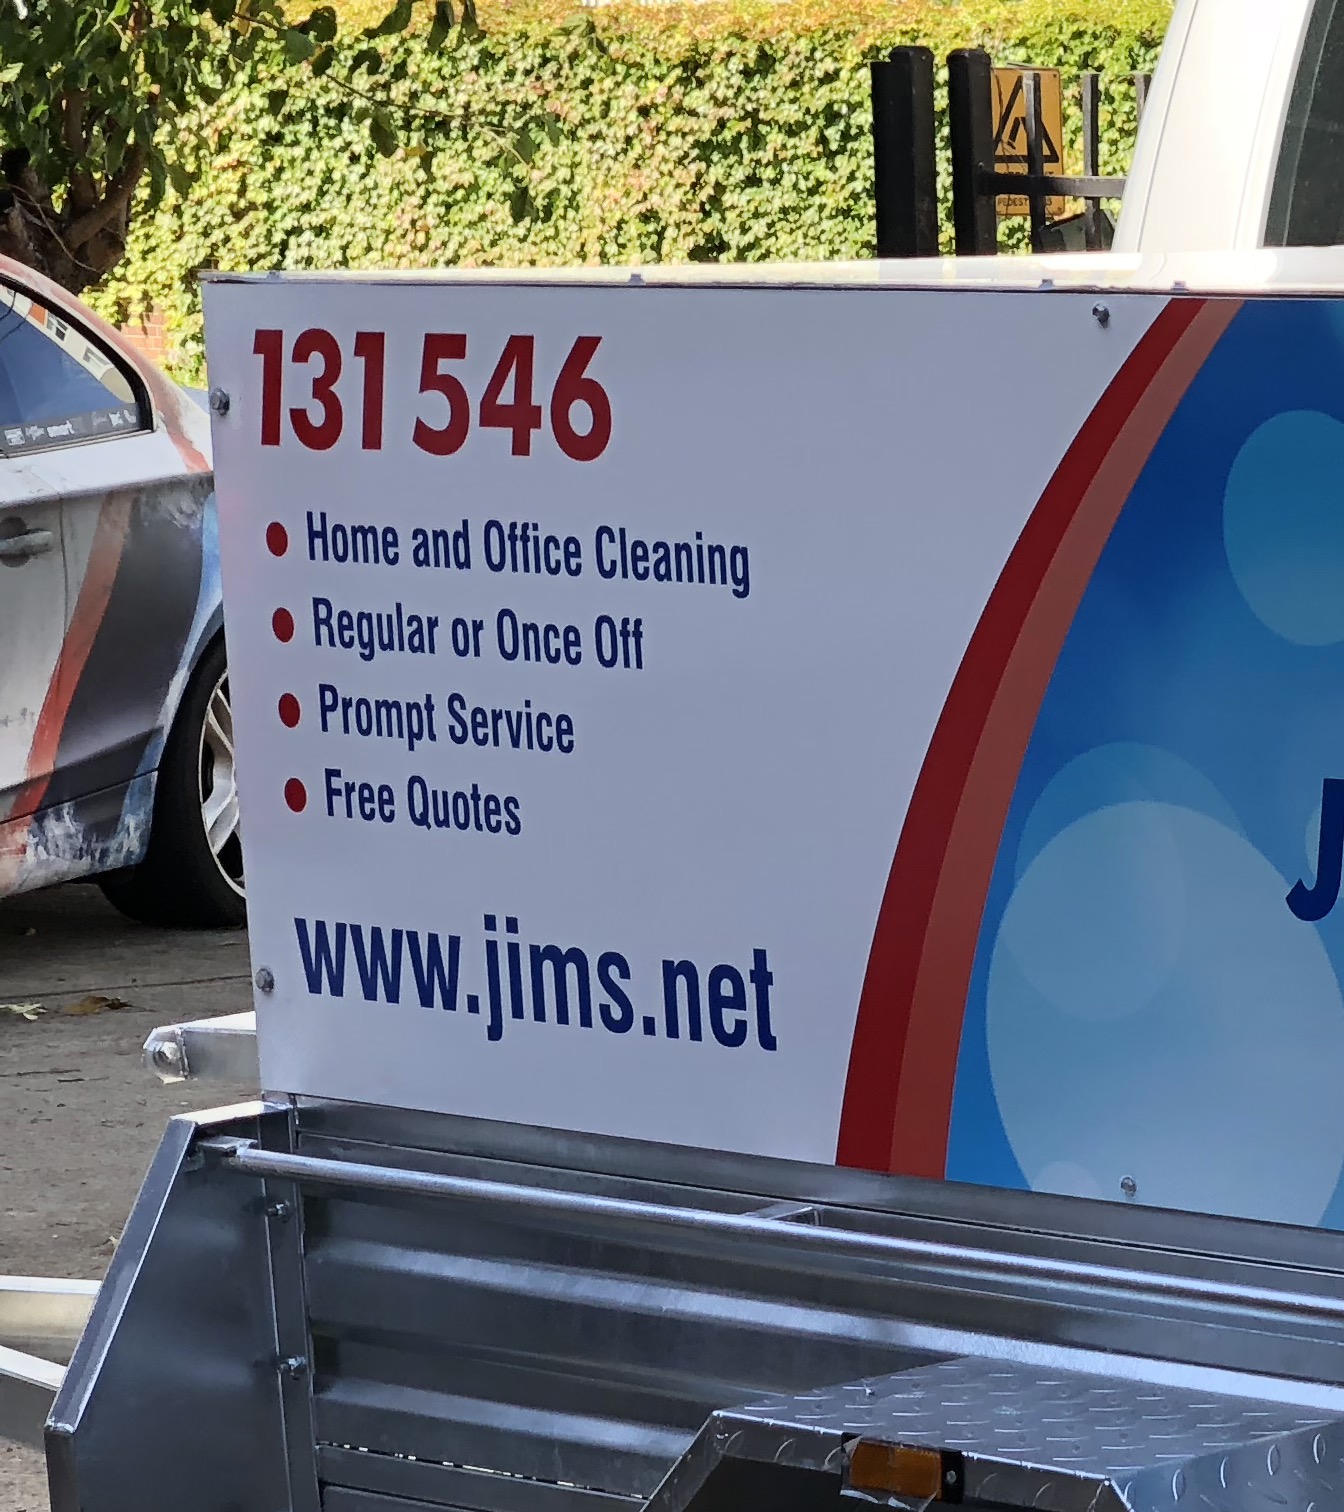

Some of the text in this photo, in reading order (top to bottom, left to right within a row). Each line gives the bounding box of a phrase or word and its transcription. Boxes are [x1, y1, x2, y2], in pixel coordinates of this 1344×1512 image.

[252, 326, 613, 462] 131 546
[305, 511, 751, 598] Home and Office Cleaning
[312, 597, 644, 670] Regular or Once Off
[318, 683, 575, 754] Prompt Service
[324, 768, 522, 836] Free Quotes
[293, 914, 778, 1052] www.jims.net
